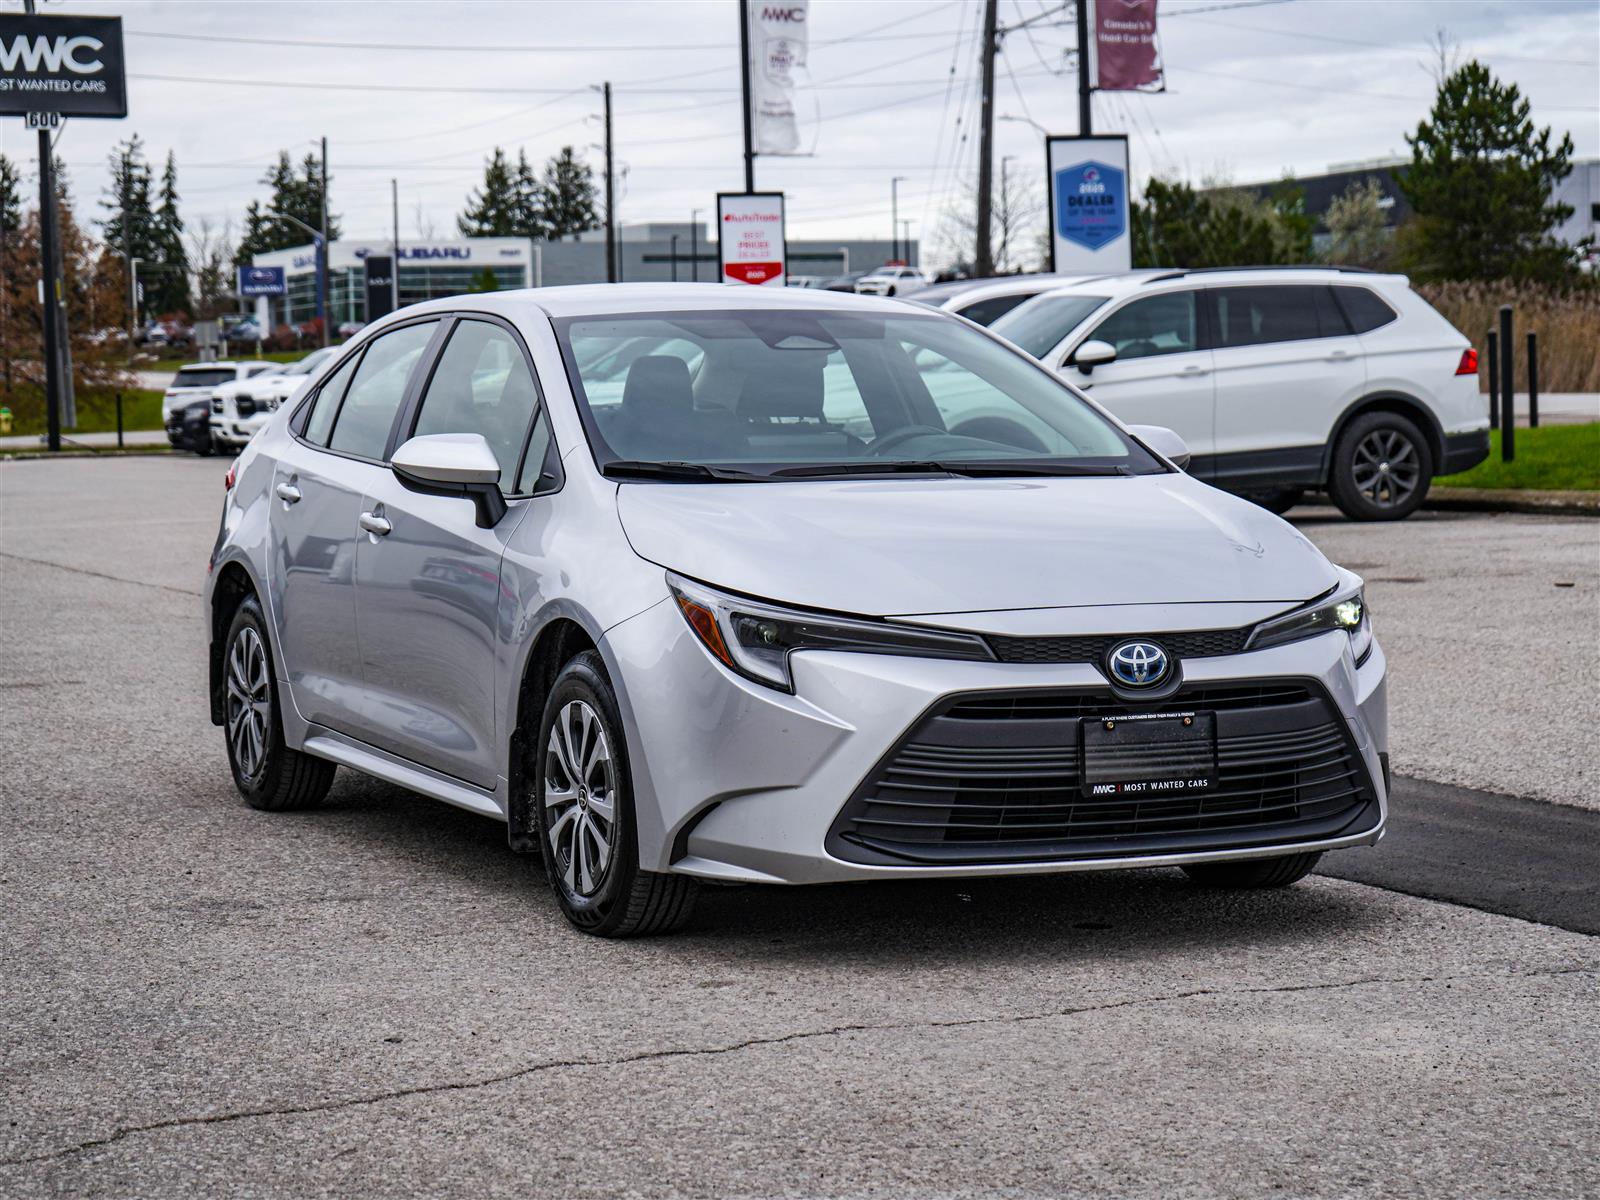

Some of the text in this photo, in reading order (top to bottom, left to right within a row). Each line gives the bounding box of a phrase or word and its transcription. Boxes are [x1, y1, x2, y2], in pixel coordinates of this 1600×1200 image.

[762, 8, 805, 22] MWC
[0, 79, 107, 93] ST WANTED CARS
[1068, 194, 1114, 207] DEALER
[243, 283, 283, 294] SUBARU
[1124, 782, 1147, 792] MOST
[1150, 780, 1184, 790] WANTED
[1188, 779, 1208, 787] CARS
